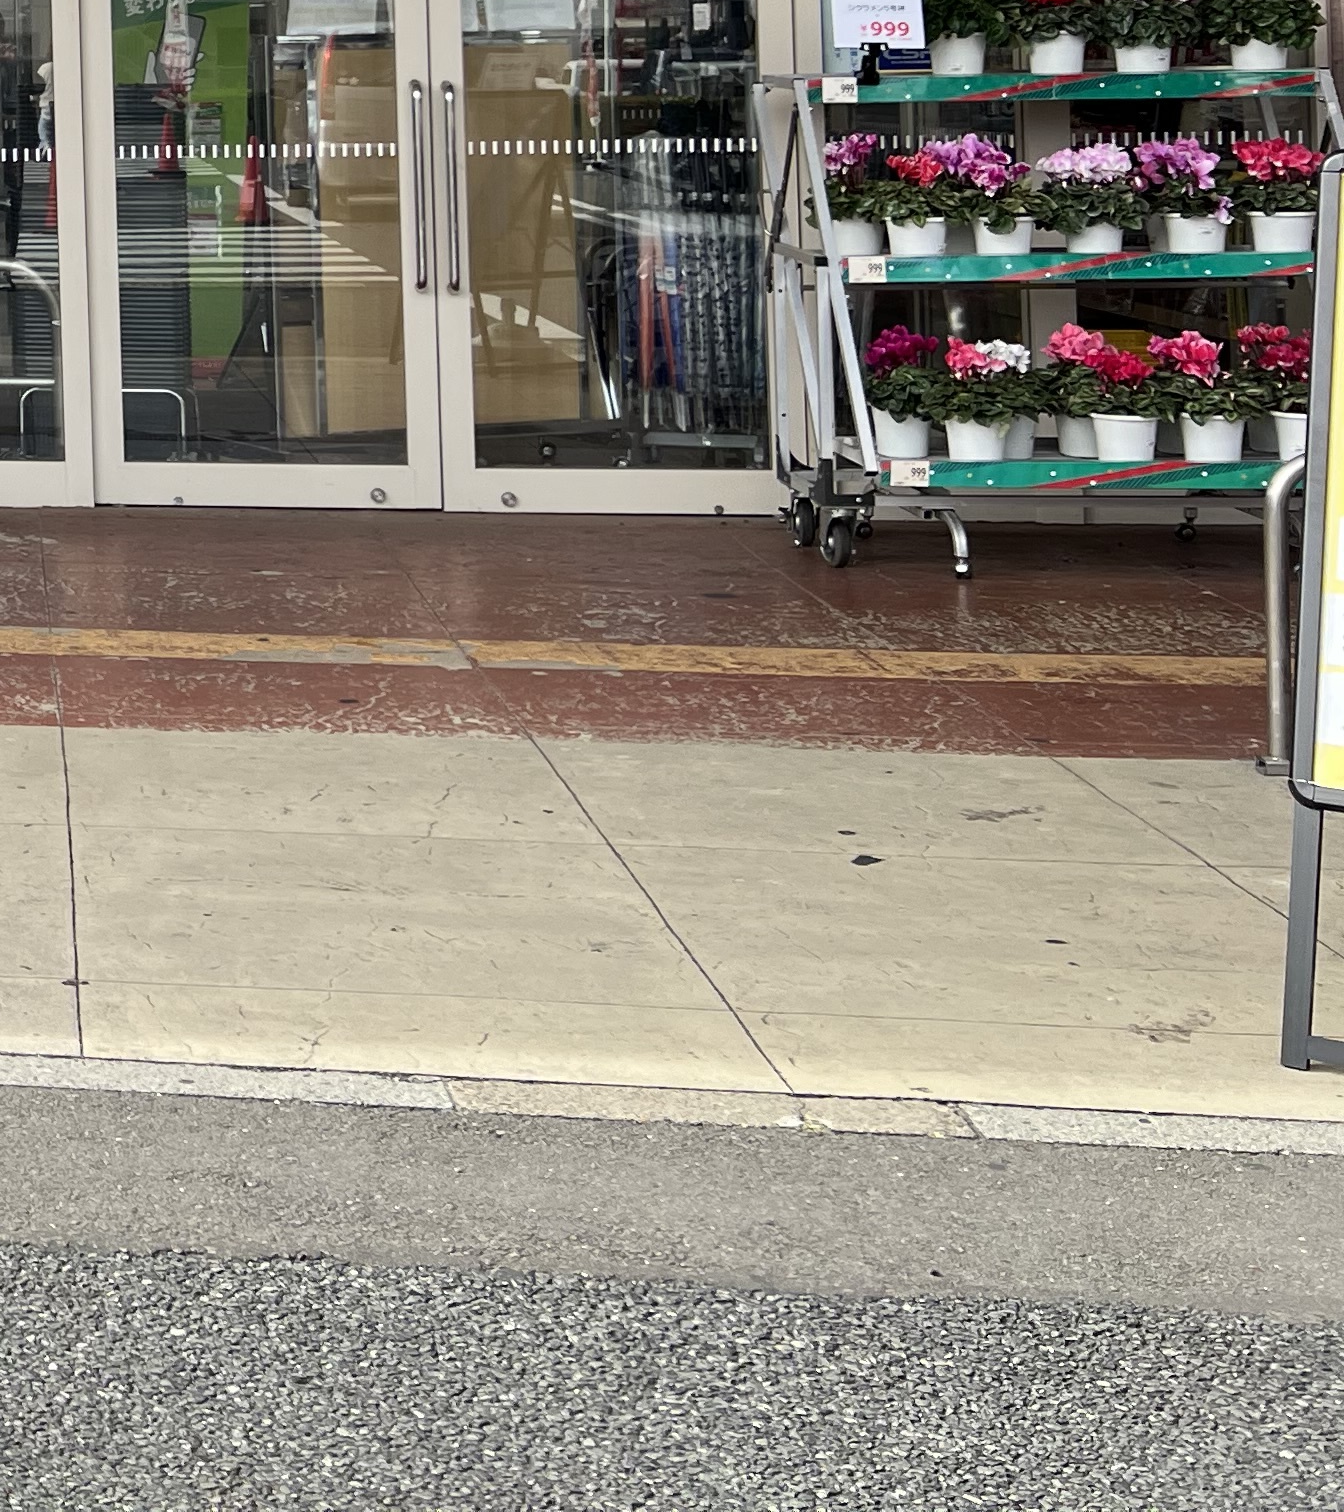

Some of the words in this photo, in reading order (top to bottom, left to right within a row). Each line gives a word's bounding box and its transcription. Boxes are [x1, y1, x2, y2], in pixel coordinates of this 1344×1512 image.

[841, 84, 855, 93] 999
[868, 263, 884, 274] 999
[911, 466, 927, 478] 999
